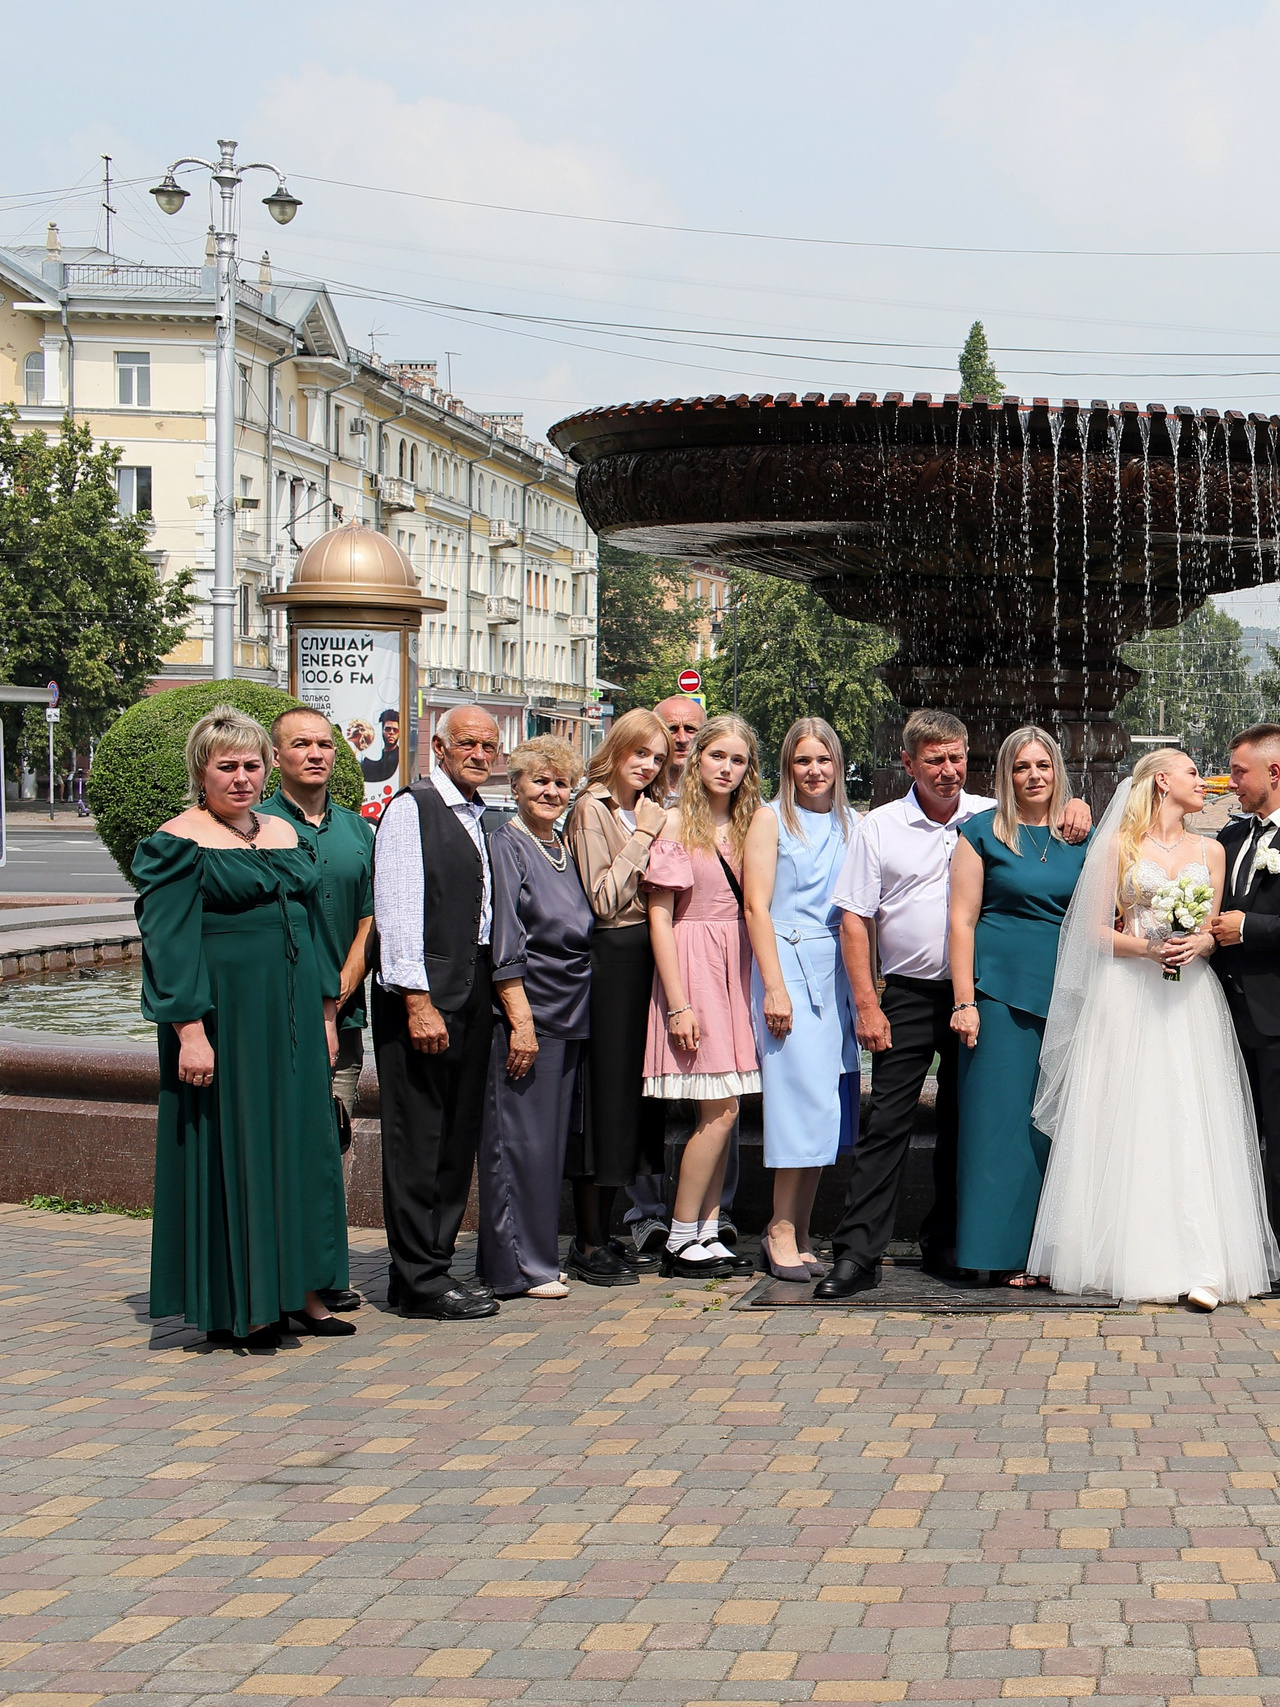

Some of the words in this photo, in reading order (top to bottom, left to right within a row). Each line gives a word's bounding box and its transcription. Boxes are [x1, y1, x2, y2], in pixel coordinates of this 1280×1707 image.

[301, 634, 373, 651] СЛУШАЙ
[302, 654, 369, 667] ENERGY
[302, 670, 343, 683] 100.6
[350, 672, 373, 684] FM
